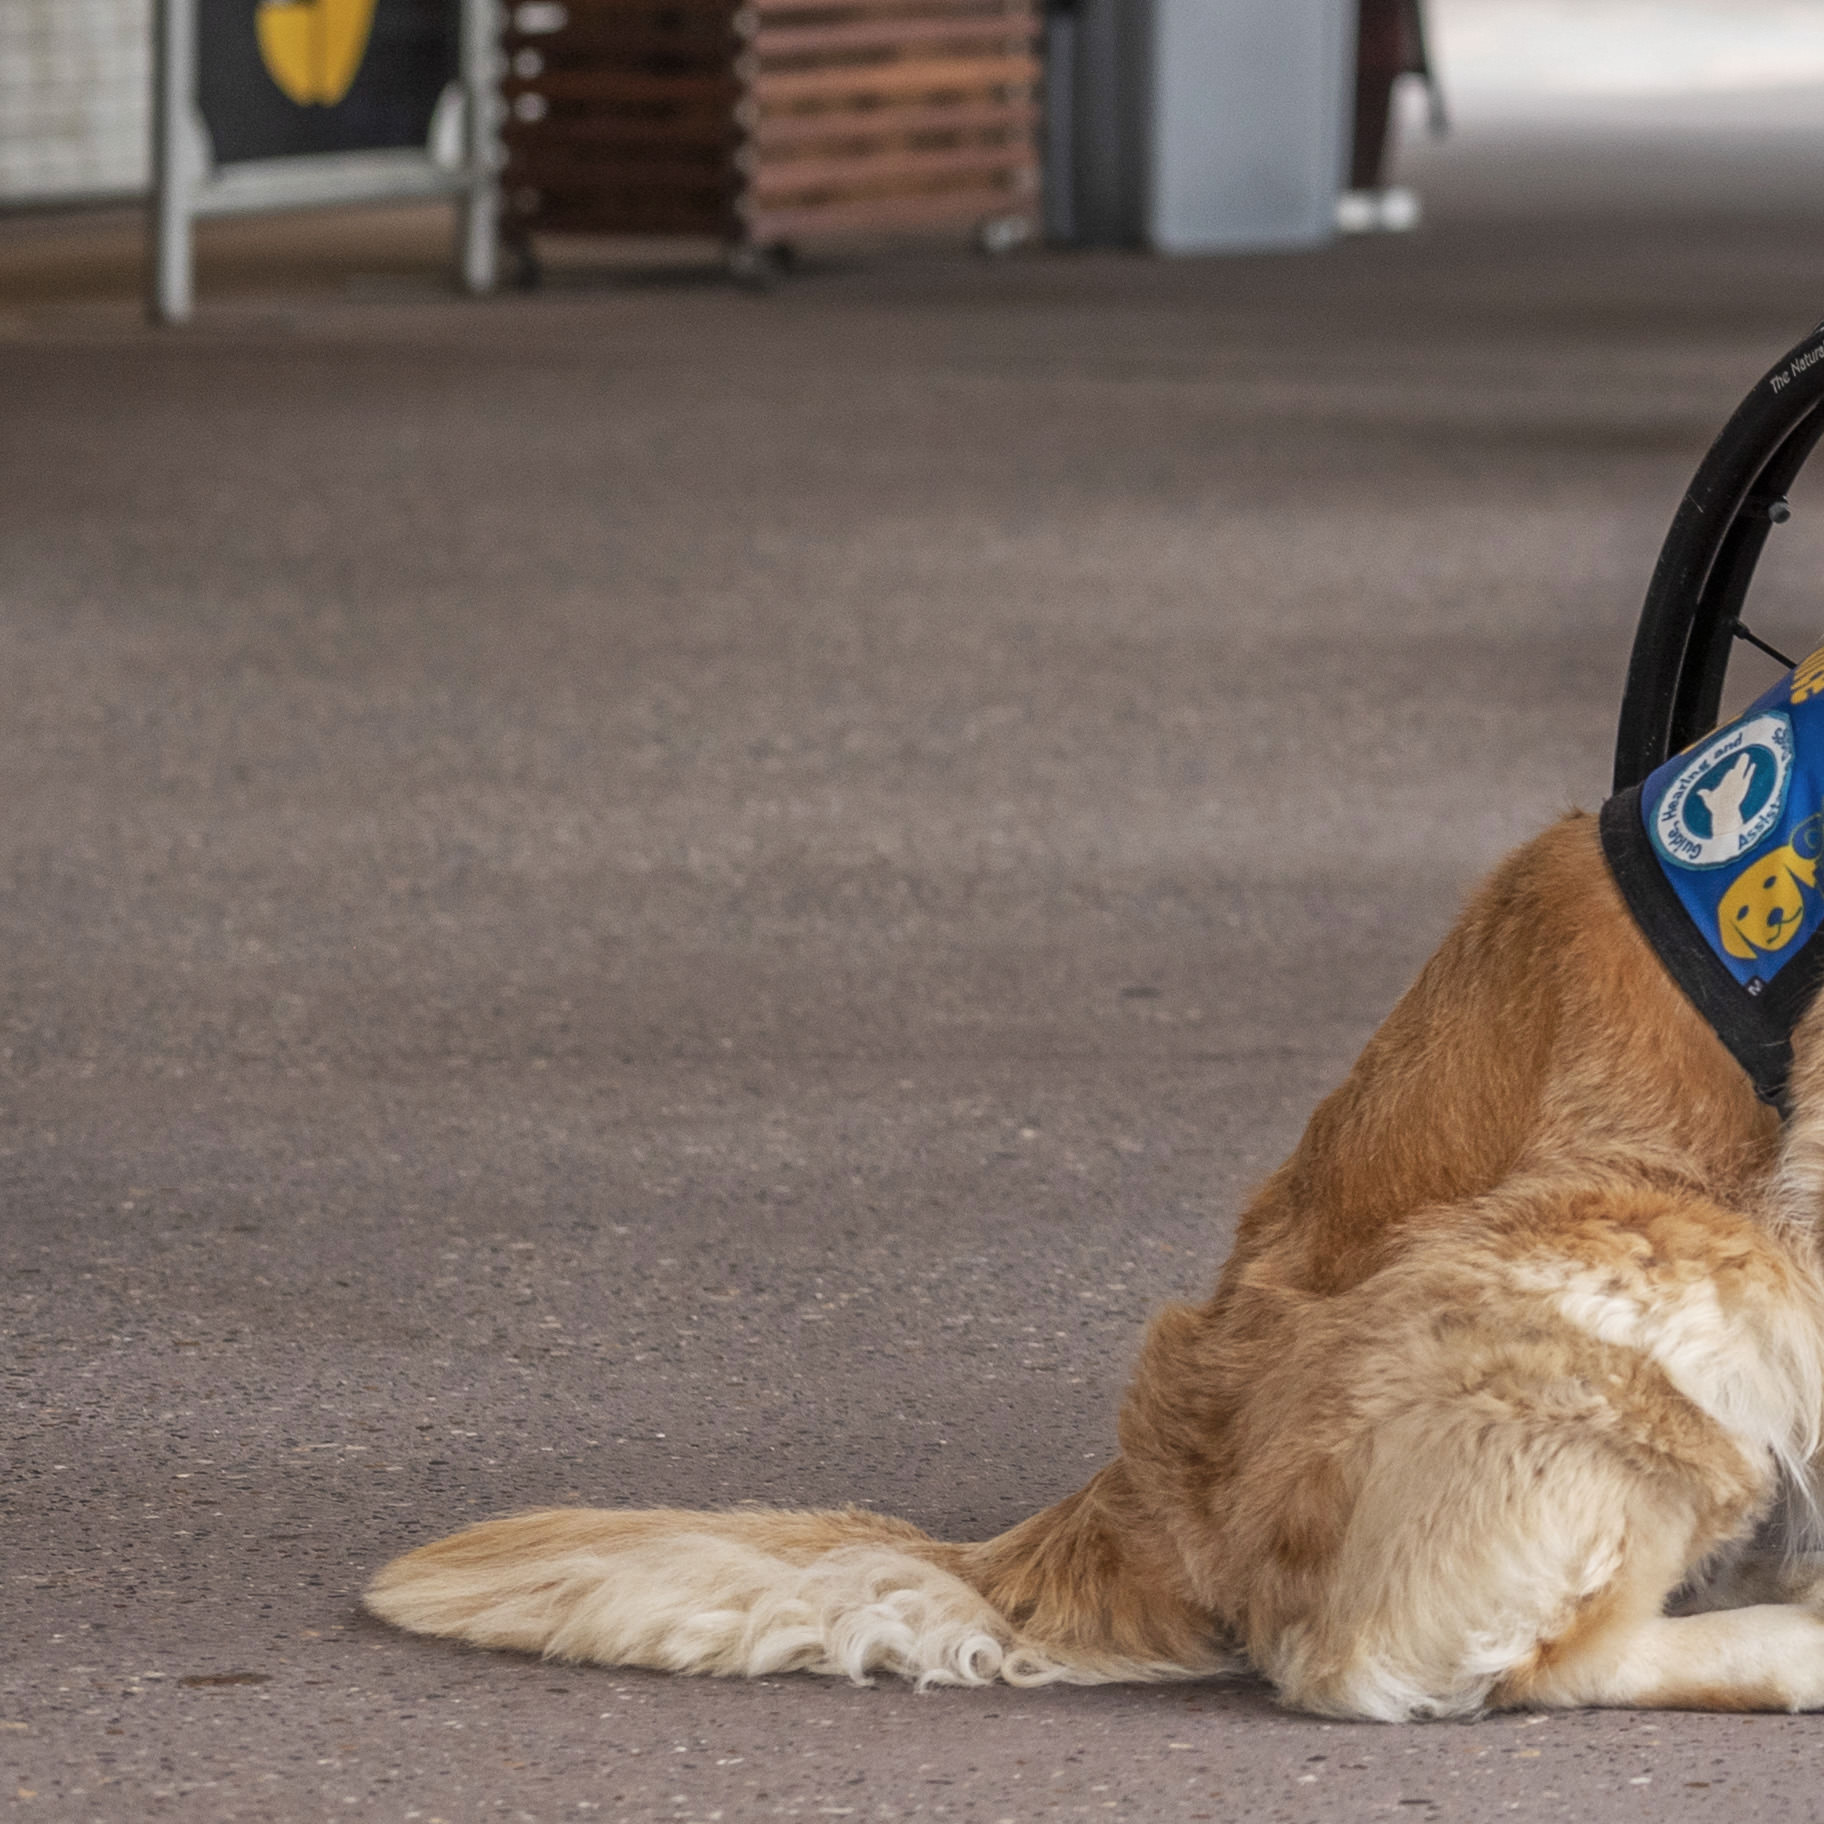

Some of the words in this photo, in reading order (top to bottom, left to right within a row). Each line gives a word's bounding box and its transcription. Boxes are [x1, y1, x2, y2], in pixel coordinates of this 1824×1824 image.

[1770, 370, 1791, 394] The
[1662, 759, 1711, 822] Hearing
[1714, 732, 1744, 759] and
